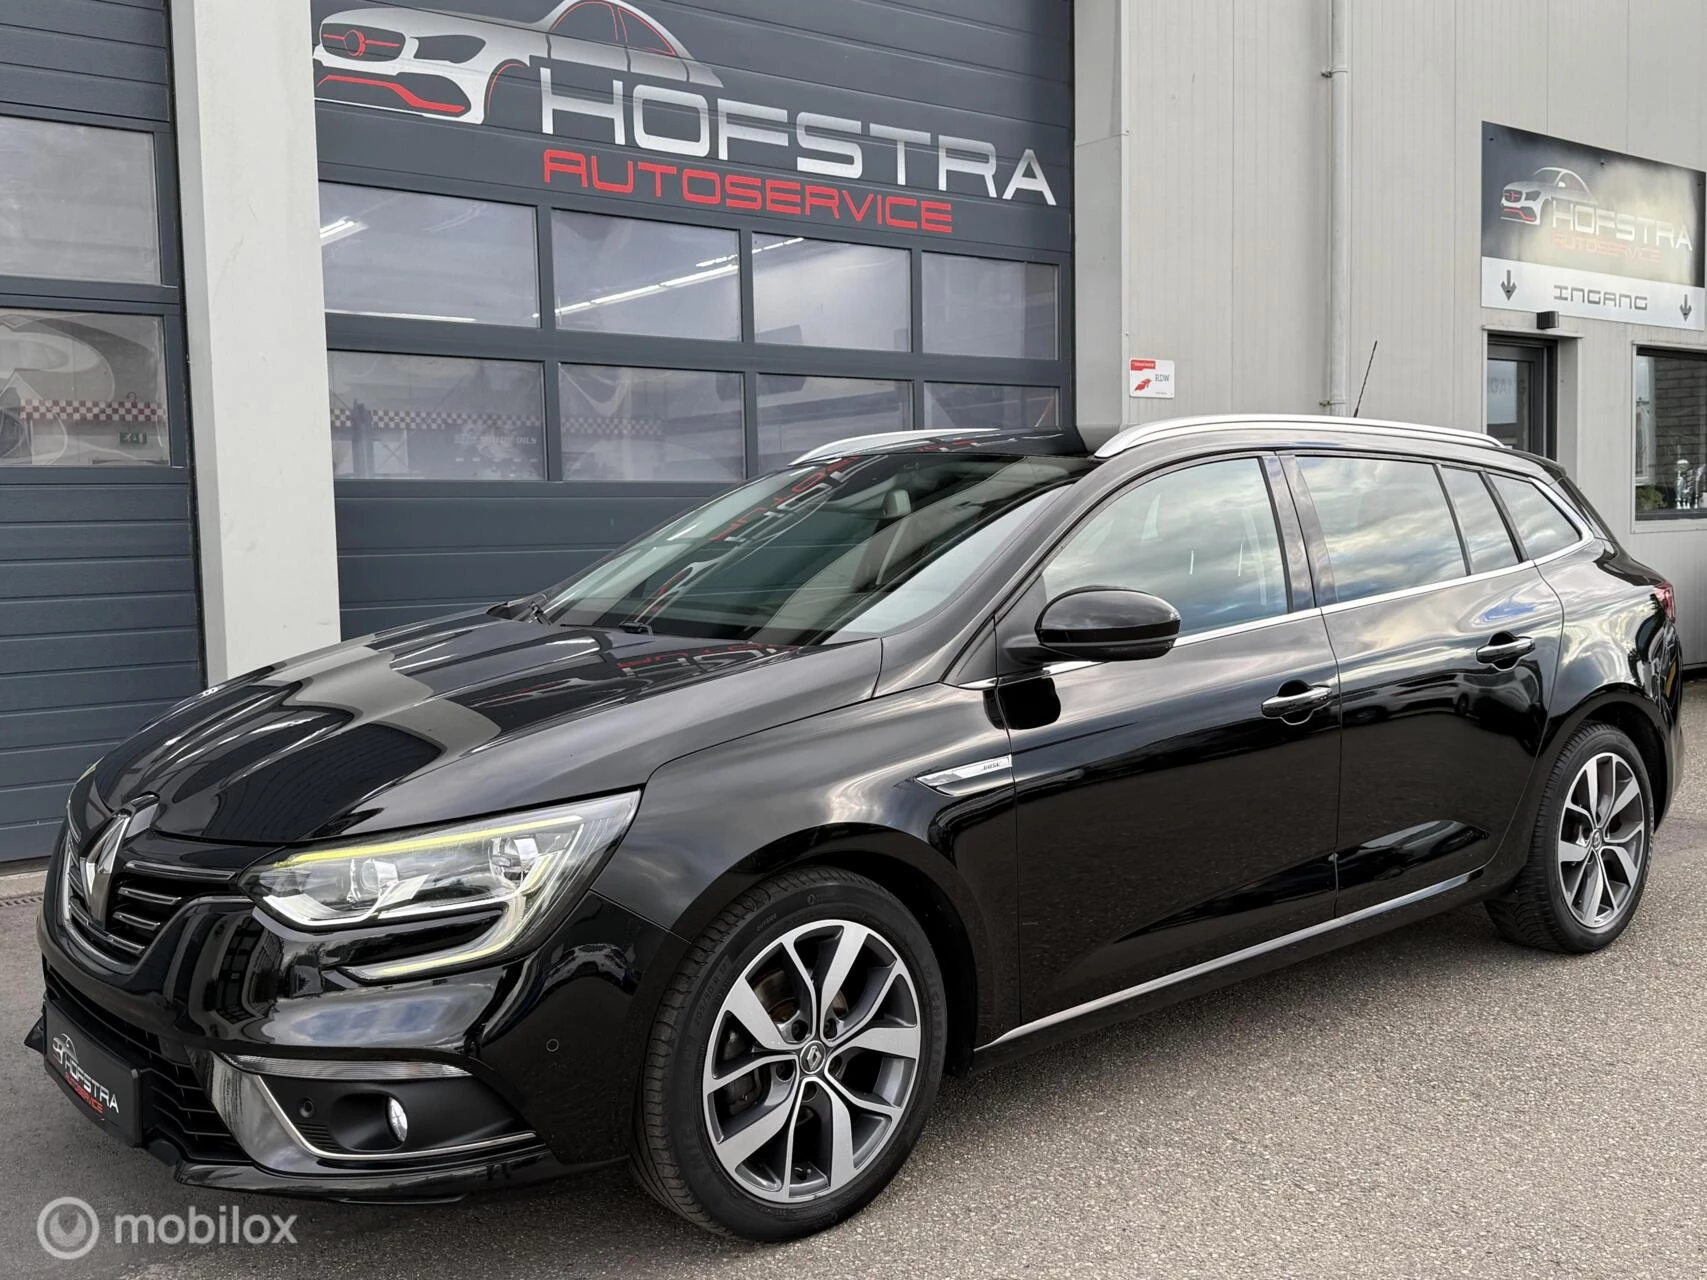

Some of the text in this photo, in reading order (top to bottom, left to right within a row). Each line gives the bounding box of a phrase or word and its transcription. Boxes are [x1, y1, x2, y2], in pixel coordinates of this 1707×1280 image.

[540, 67, 1056, 206] HOFSTRA
[542, 149, 953, 233] AUTOSERVICE
[1553, 201, 1693, 251] HOFSTRA
[1553, 284, 1648, 311] INGANG
[64, 1051, 120, 1114] HOFSTRA
